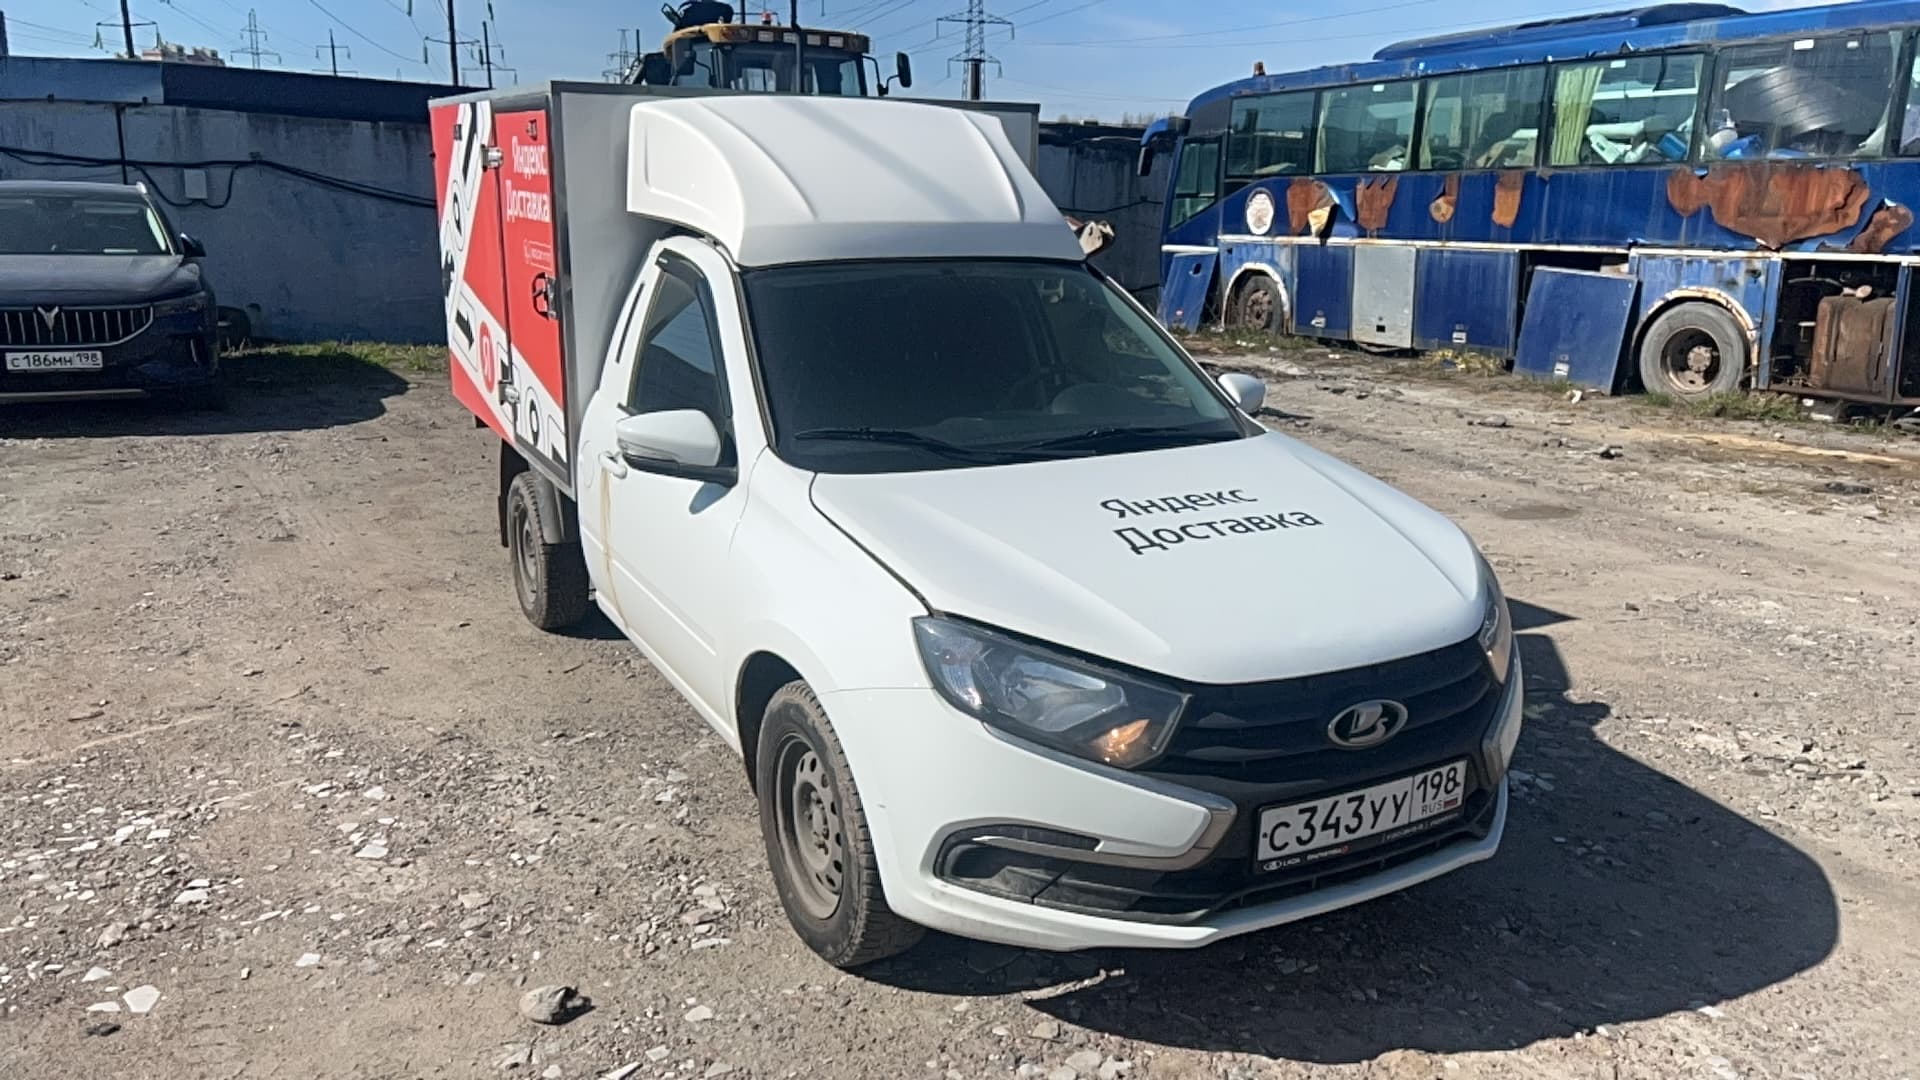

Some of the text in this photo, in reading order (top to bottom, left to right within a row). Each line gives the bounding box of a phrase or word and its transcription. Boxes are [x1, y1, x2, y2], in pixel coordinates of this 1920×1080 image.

[511, 135, 548, 180] Яндекс
[505, 179, 551, 223] Доставка
[11, 354, 73, 368] С186МН
[1100, 489, 1258, 518] Яндекс
[1113, 511, 1324, 555] Доставка
[1268, 790, 1408, 852] С343УУ
[1416, 766, 1457, 804] 198
[1421, 799, 1443, 816] RUS
